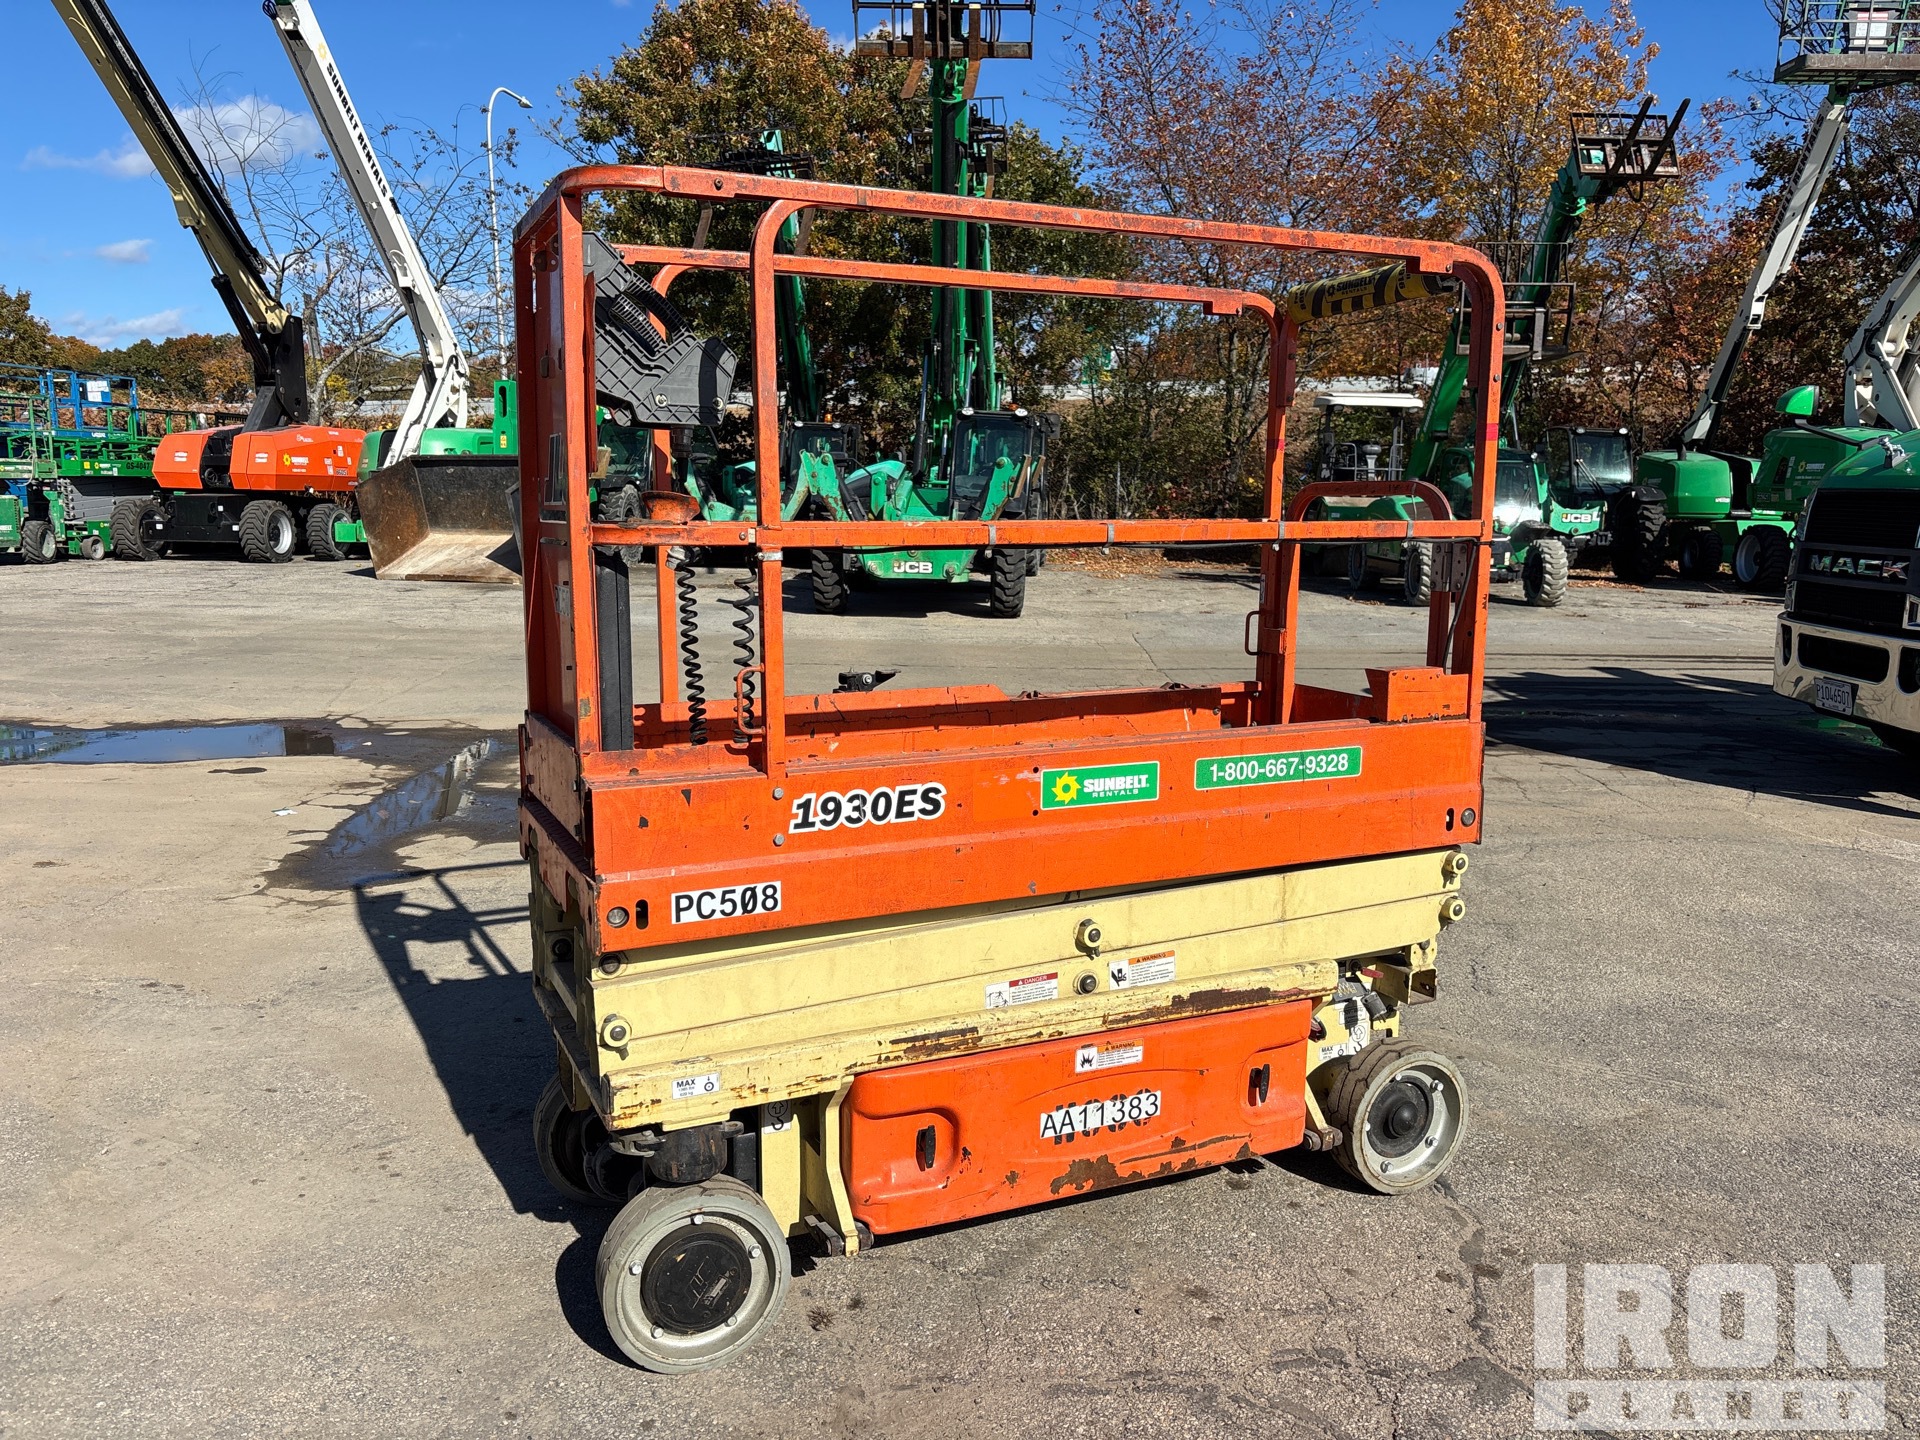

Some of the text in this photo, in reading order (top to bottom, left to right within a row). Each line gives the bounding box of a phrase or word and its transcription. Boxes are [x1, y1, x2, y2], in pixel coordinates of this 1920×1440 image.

[327, 63, 388, 198] SUNBELT RENTALS
[1793, 114, 1825, 186] RENTALS
[1562, 513, 1591, 523] JCB
[893, 561, 932, 573] JCB
[1810, 554, 1909, 580] MACK
[1210, 753, 1349, 782] 1-800-667-9328
[1083, 774, 1149, 793] SUNBELT
[1092, 789, 1139, 798] RENTALS
[790, 784, 946, 832] 1930ES
[1142, 953, 1166, 961] WARNING
[1024, 975, 1047, 984] DANGER
[1111, 1042, 1135, 1050] WARNING
[676, 1078, 696, 1088] MAX
[1041, 1093, 1159, 1138] AA11383
